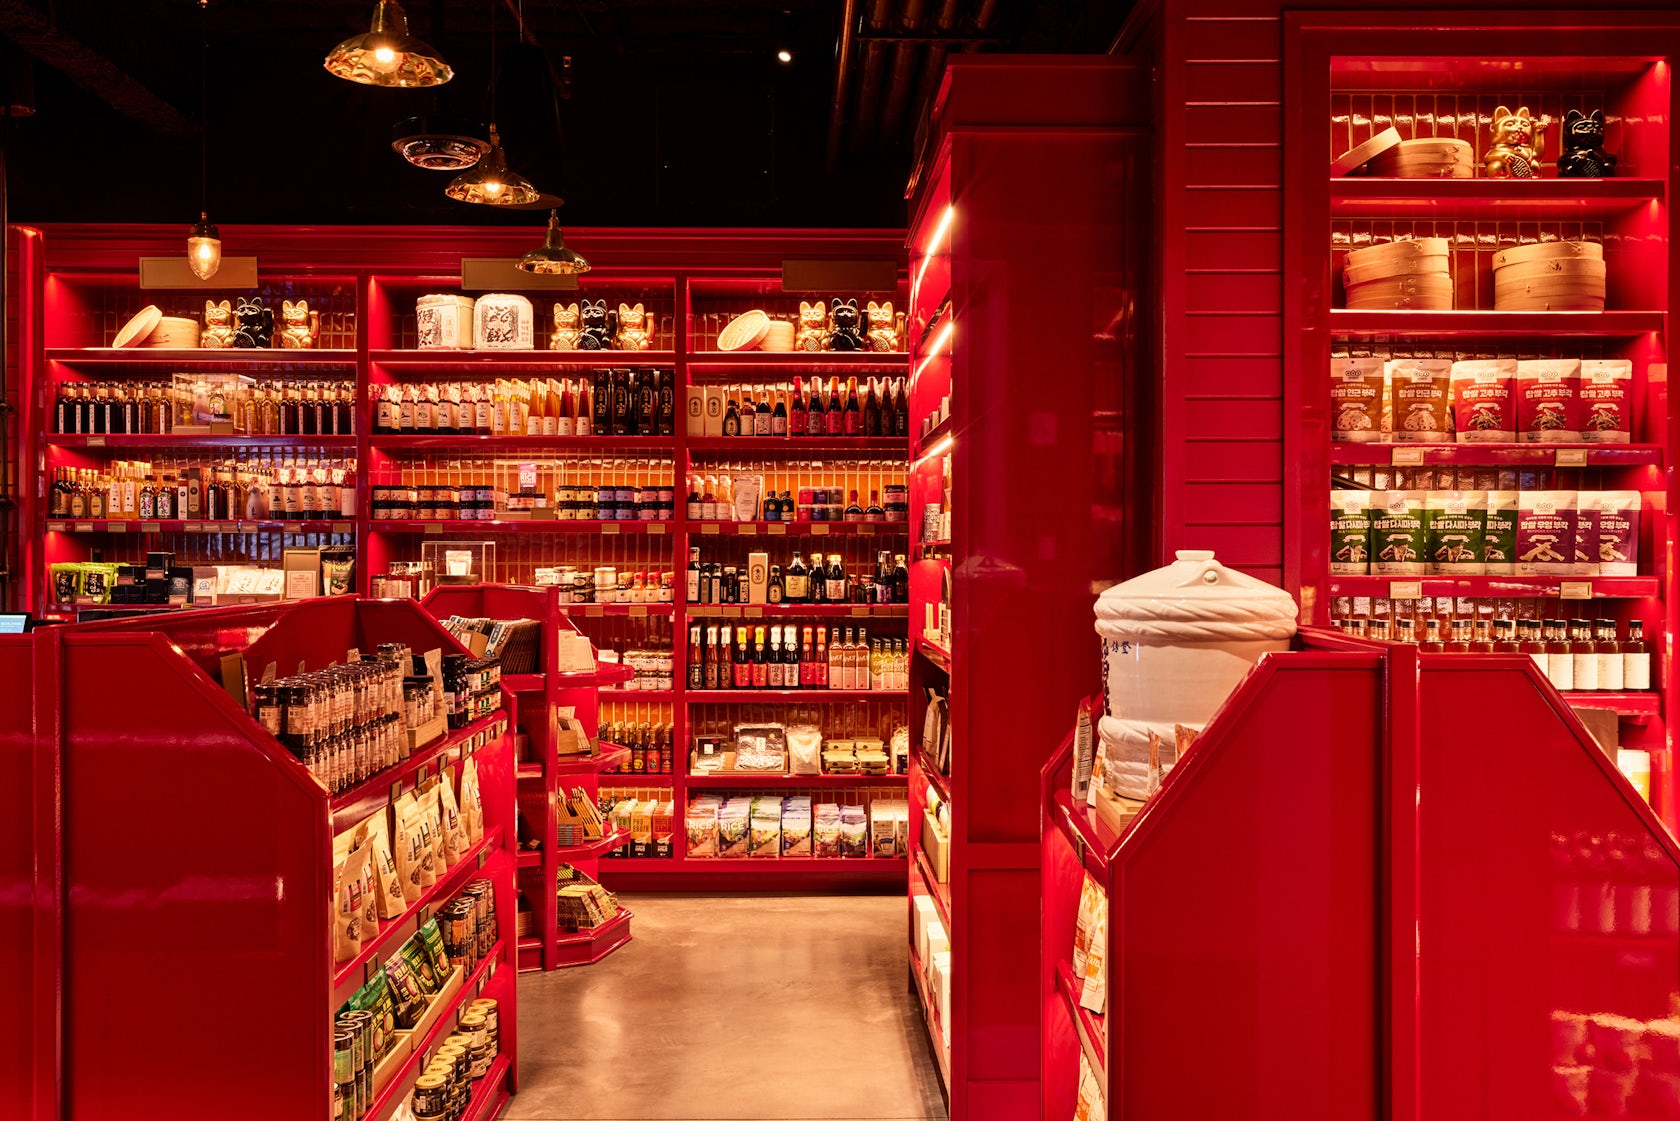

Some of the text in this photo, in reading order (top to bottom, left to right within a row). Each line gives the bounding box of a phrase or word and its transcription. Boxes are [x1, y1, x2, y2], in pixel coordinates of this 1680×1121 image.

[1462, 388, 1509, 399] 찹쌀 고추 부각
[1525, 389, 1573, 399] 찹쌀 고추 부각
[1580, 389, 1624, 399] 찹쌀 고추 부각
[1346, 520, 1363, 529] 다시마
[1374, 520, 1421, 529] 찹쌀 다시마 부각
[1430, 520, 1482, 530] 찹쌀 다시마 부각
[1497, 521, 1513, 530] 부각
[1520, 521, 1536, 530] 찹쌀
[1553, 521, 1569, 530] 부각
[1615, 521, 1630, 530] 부각
[689, 820, 713, 830] RICE
[721, 822, 745, 831] RICE
[816, 826, 839, 834] RICE
